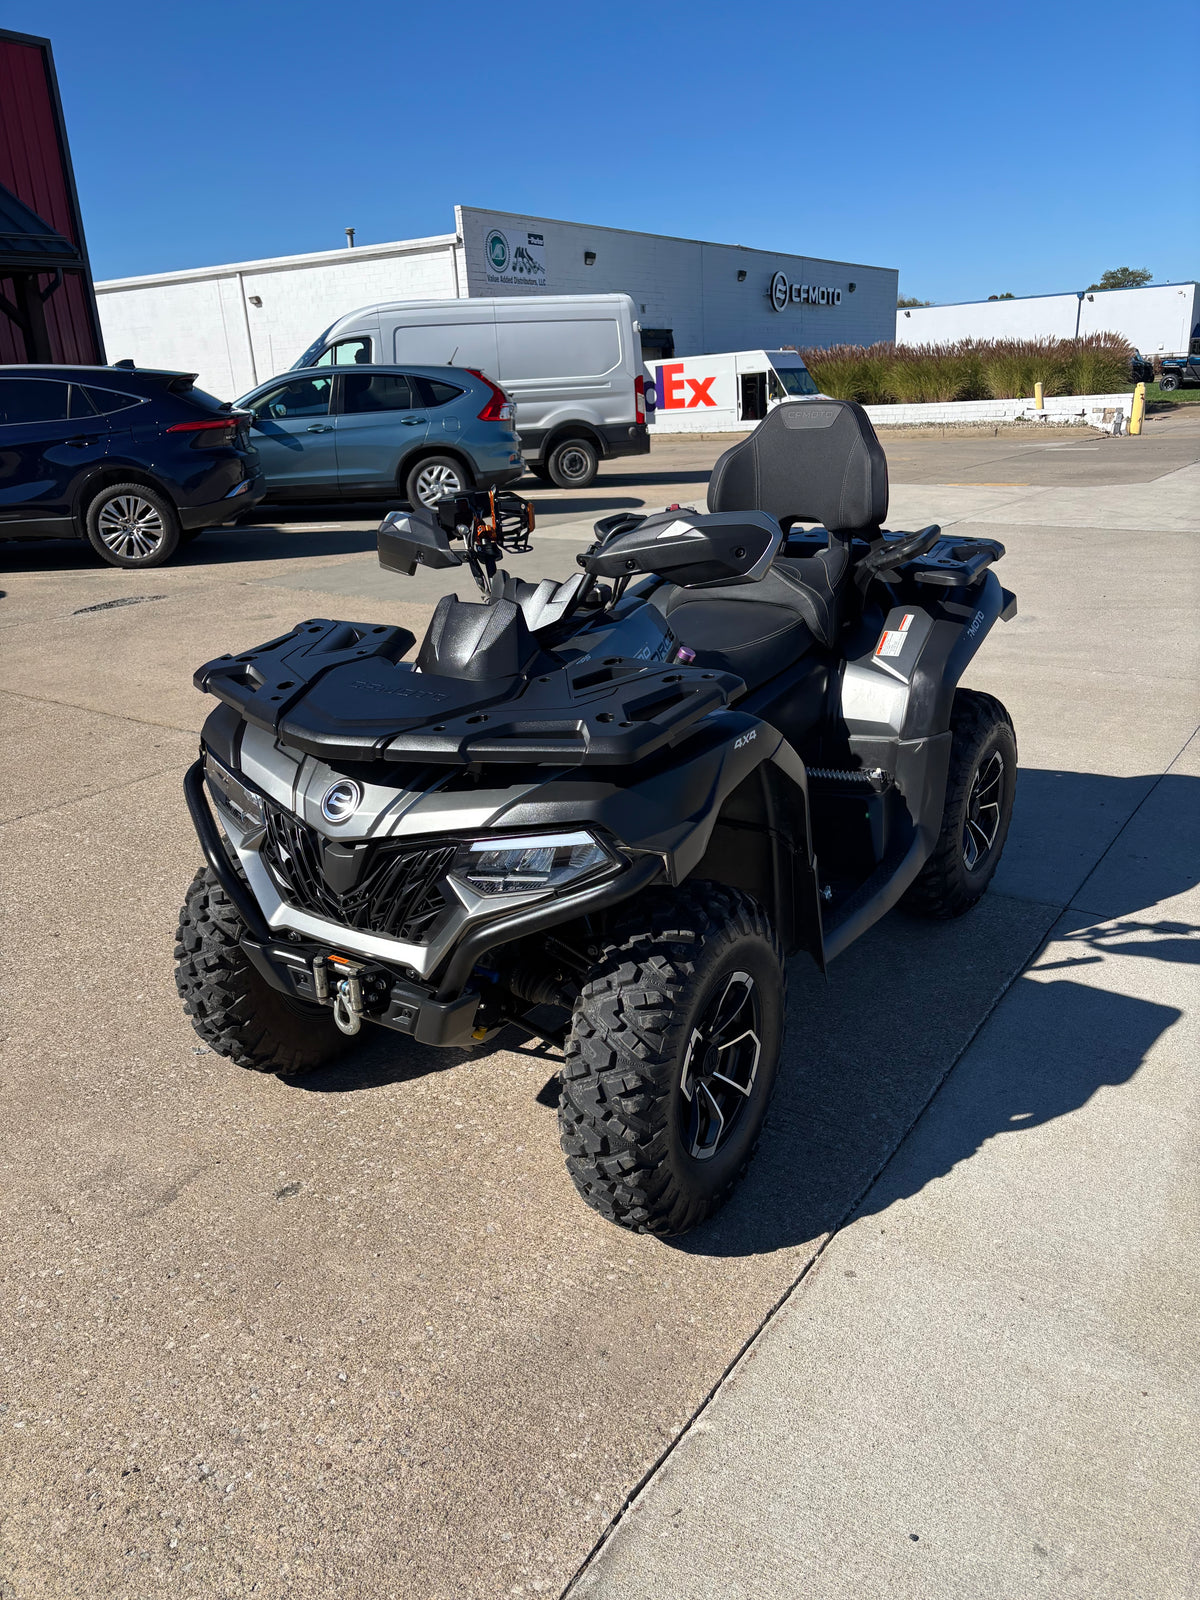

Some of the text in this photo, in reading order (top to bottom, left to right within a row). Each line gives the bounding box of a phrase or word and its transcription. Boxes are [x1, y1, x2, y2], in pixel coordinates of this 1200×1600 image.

[790, 283, 842, 306] CFMOTO
[643, 363, 718, 412] dEx
[967, 610, 985, 640] MOTO
